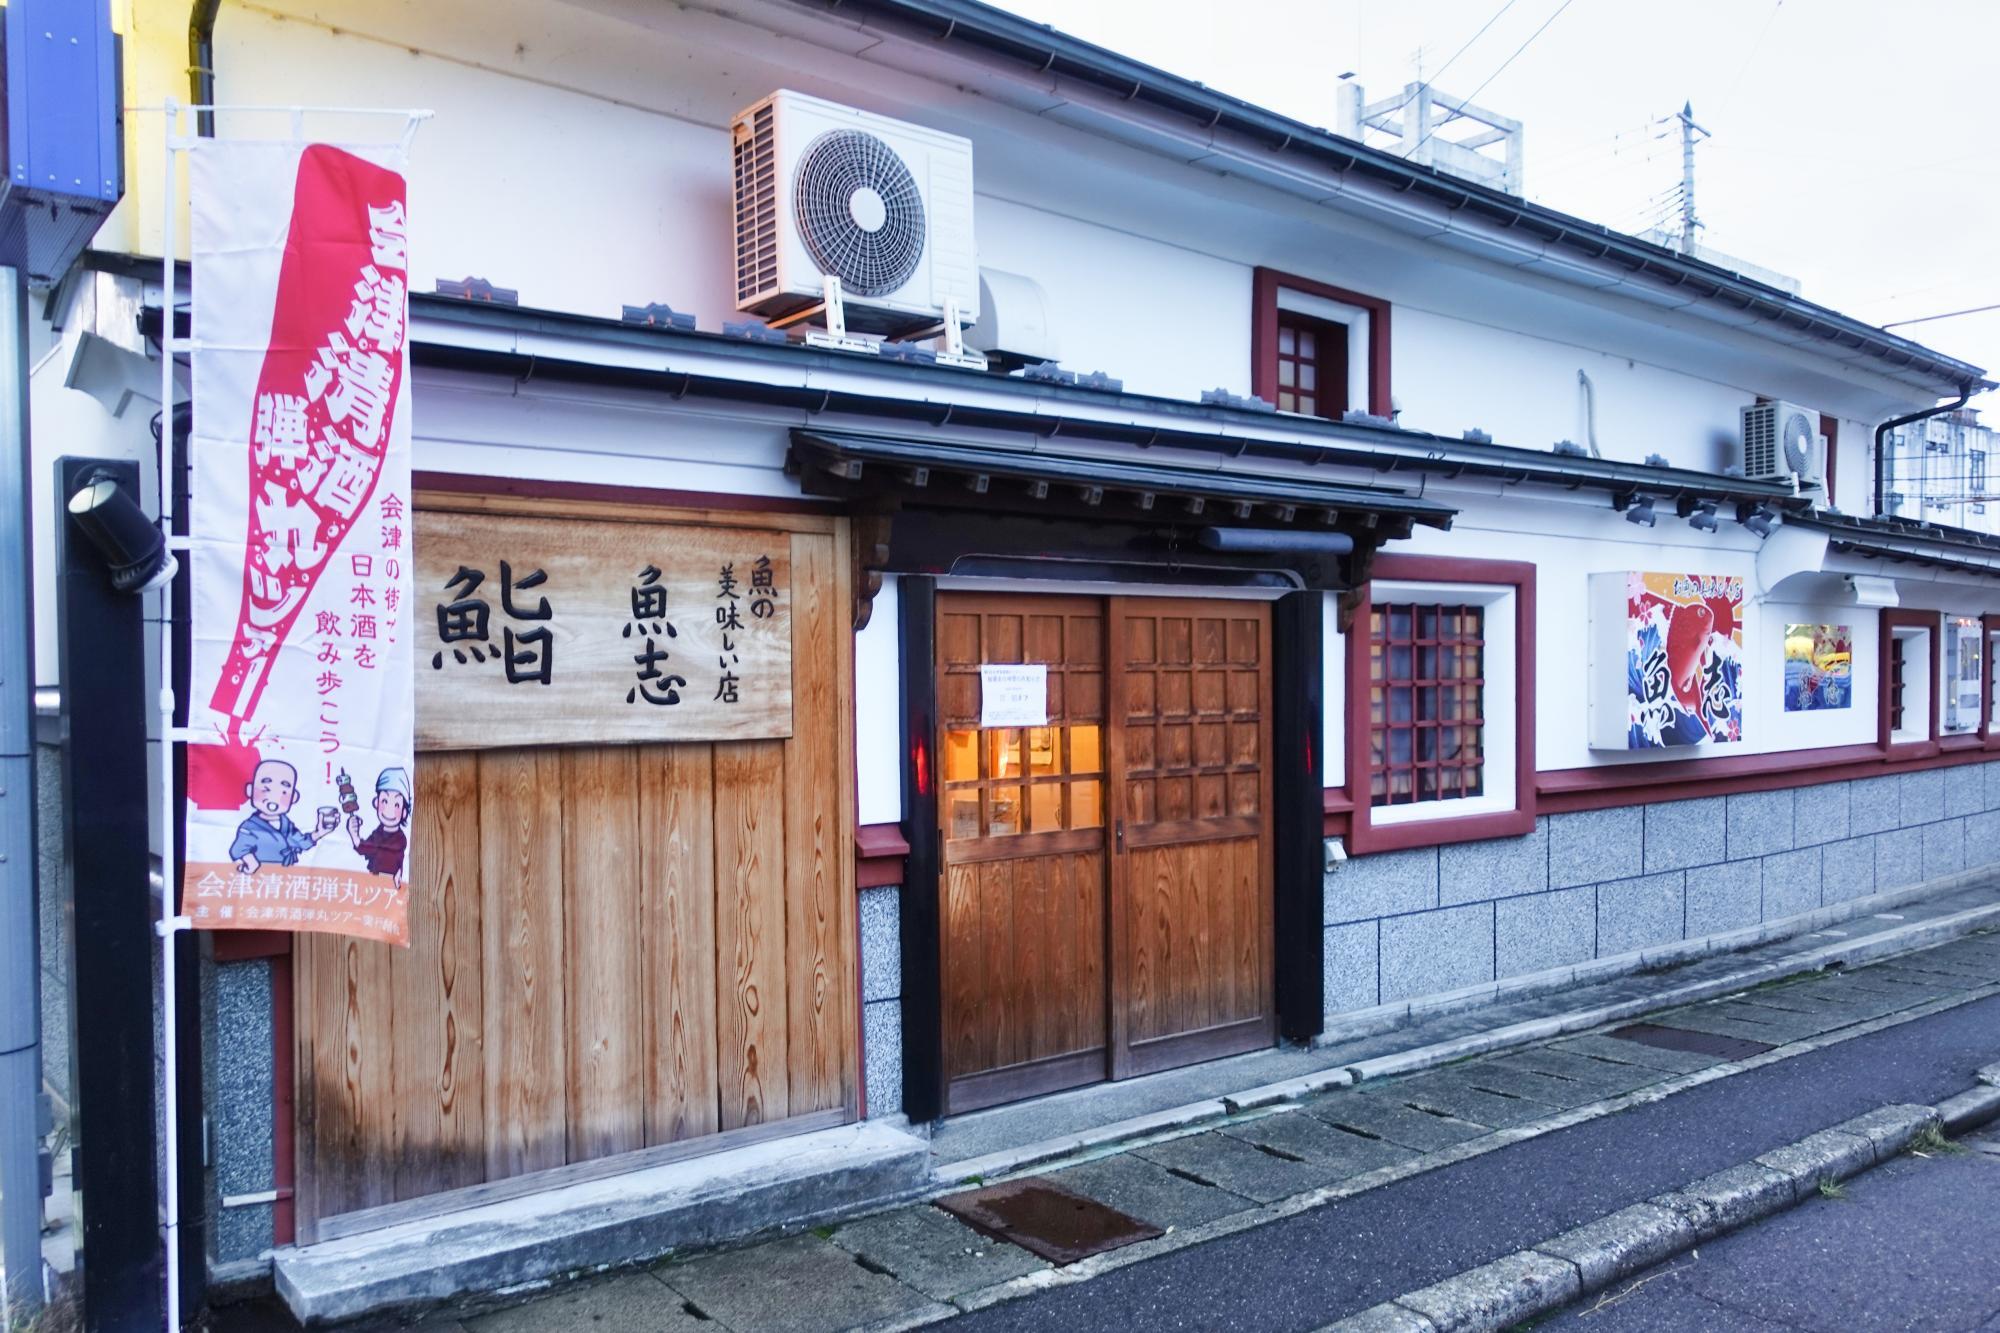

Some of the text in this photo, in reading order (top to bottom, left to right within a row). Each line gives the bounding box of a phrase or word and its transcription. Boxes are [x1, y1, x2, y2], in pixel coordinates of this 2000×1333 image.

[297, 200, 406, 520] 会津清酒
[231, 391, 328, 719] 弾丸ツアー
[350, 554, 377, 669] 日本酒を
[432, 559, 553, 685] 鮨
[749, 555, 778, 618] 魚の
[315, 610, 343, 785] 飲み歩こう！
[622, 565, 687, 705] 魚志
[713, 560, 745, 703] 美味しい店
